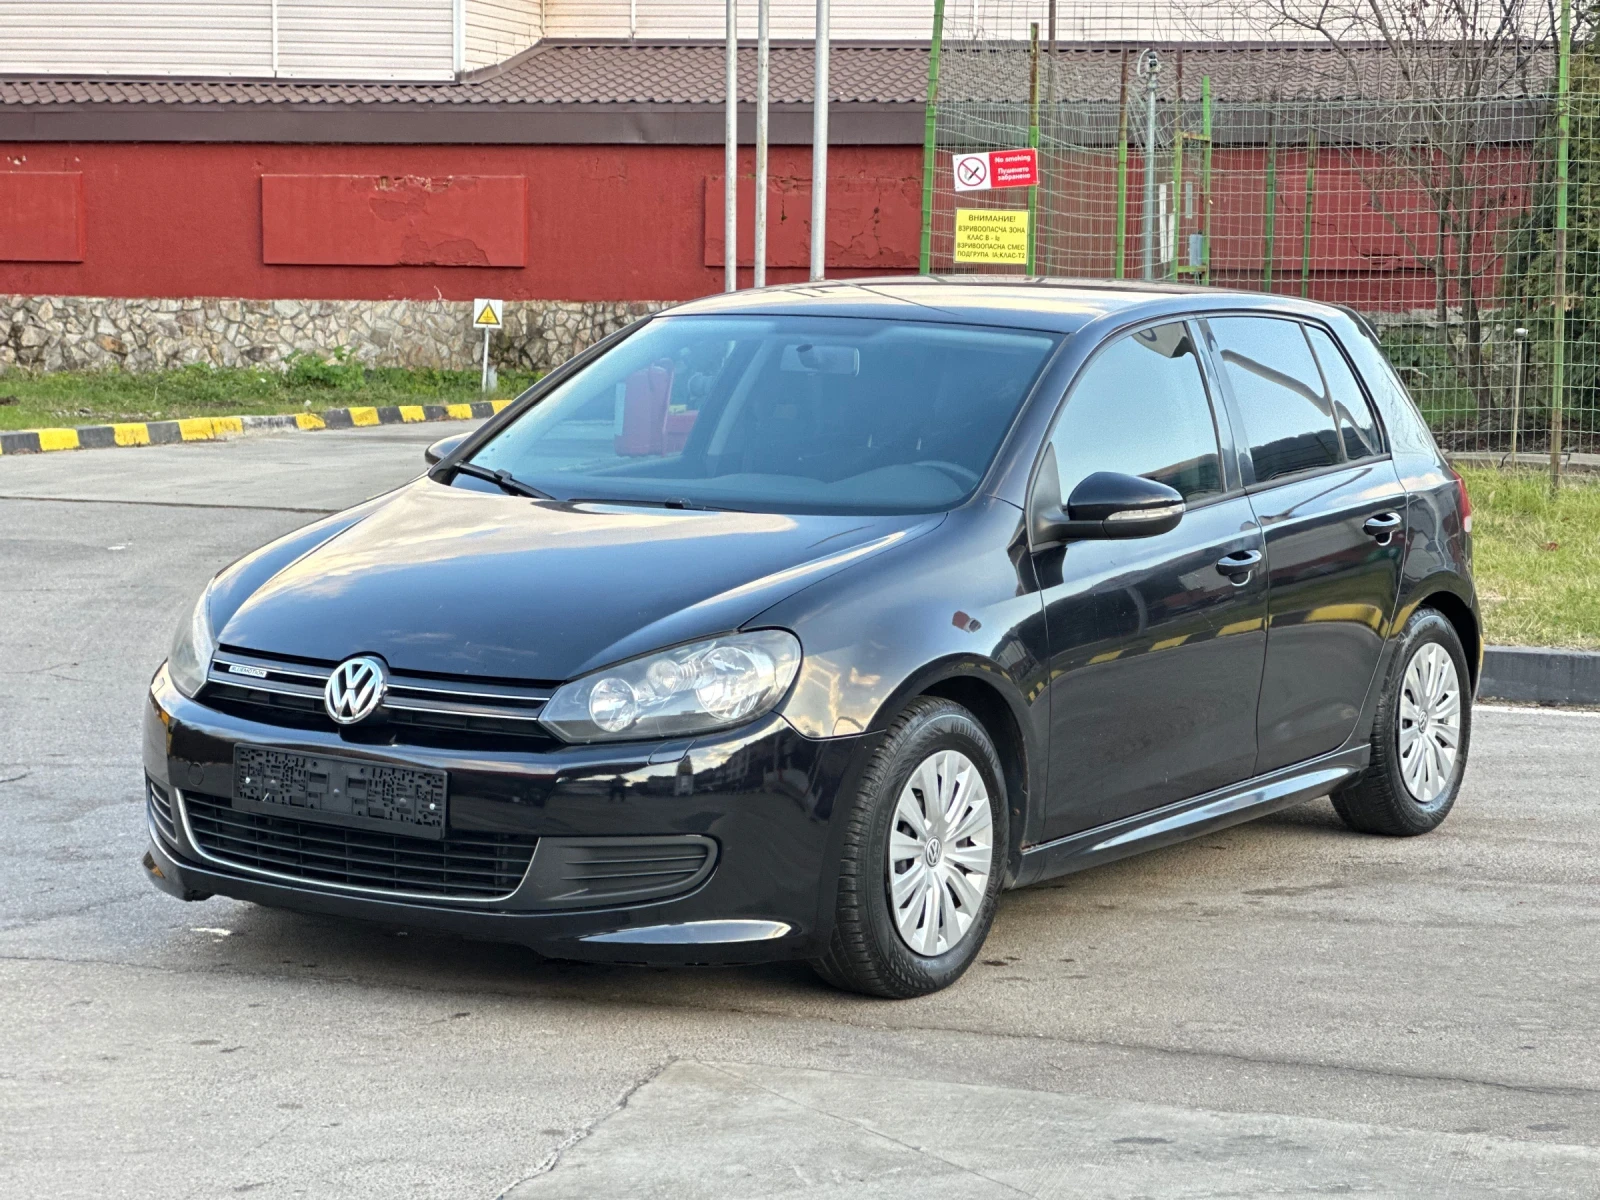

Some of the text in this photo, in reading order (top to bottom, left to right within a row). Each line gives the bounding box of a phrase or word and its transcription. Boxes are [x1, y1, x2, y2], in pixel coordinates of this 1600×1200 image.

[1005, 154, 1031, 162] smoking
[998, 166, 1029, 175] Пушенето
[998, 173, 1031, 181] забранено
[968, 214, 1016, 223] ВНИМАНИЕ!
[1008, 226, 1026, 234] ЗОНА
[956, 242, 1006, 250] ВЗРИВООПАСНА
[957, 250, 989, 258] ПОДГРУПА
[325, 657, 385, 723] VW
